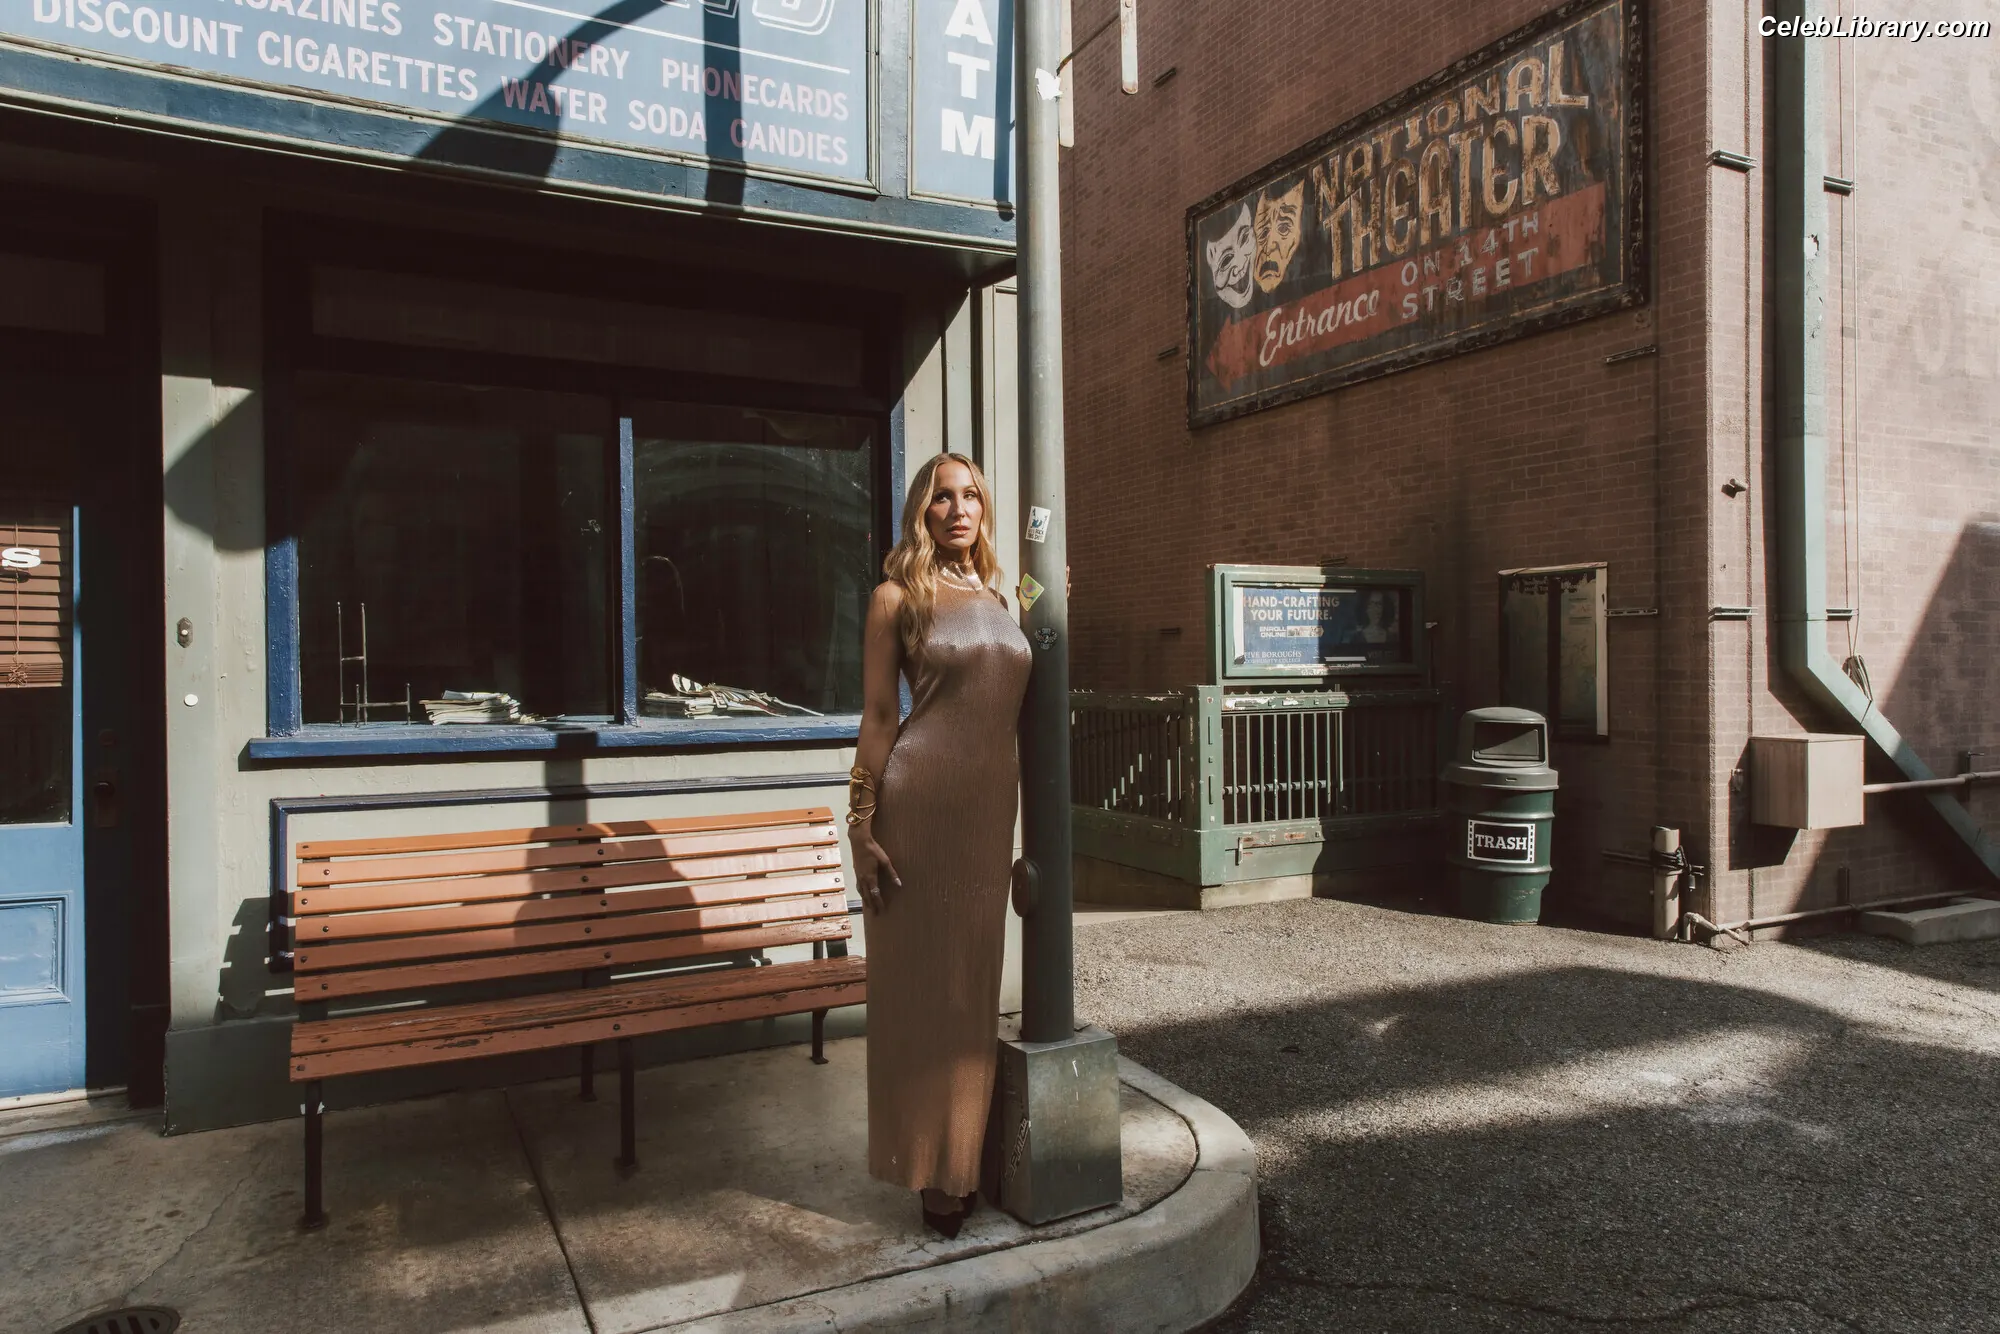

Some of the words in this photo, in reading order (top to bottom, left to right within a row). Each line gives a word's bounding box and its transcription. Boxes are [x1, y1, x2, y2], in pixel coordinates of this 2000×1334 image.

[33, 0, 243, 58] DISCOUNT
[258, 31, 478, 101] CIGARETTES
[501, 75, 607, 125] WATER
[628, 99, 707, 142] SODA
[730, 118, 849, 166] CANDIES
[217, 0, 402, 36] ZINES
[433, 12, 630, 80] STATIONERY
[662, 58, 849, 121] PHONECARDS
[1312, 39, 1589, 221] NATIONAL
[1323, 115, 1561, 280] THEATER
[1401, 250, 1441, 287] ON
[1458, 211, 1539, 267] 14TH
[1402, 248, 1539, 319] STREET
[1259, 288, 1380, 367] Entrance
[1243, 595, 1340, 608] HAND-CRAFTING
[1250, 609, 1283, 621] YOUR
[1287, 608, 1332, 621] FUTURE.
[1262, 650, 1302, 658] BOROUGHS
[1475, 834, 1527, 850] TRASH
